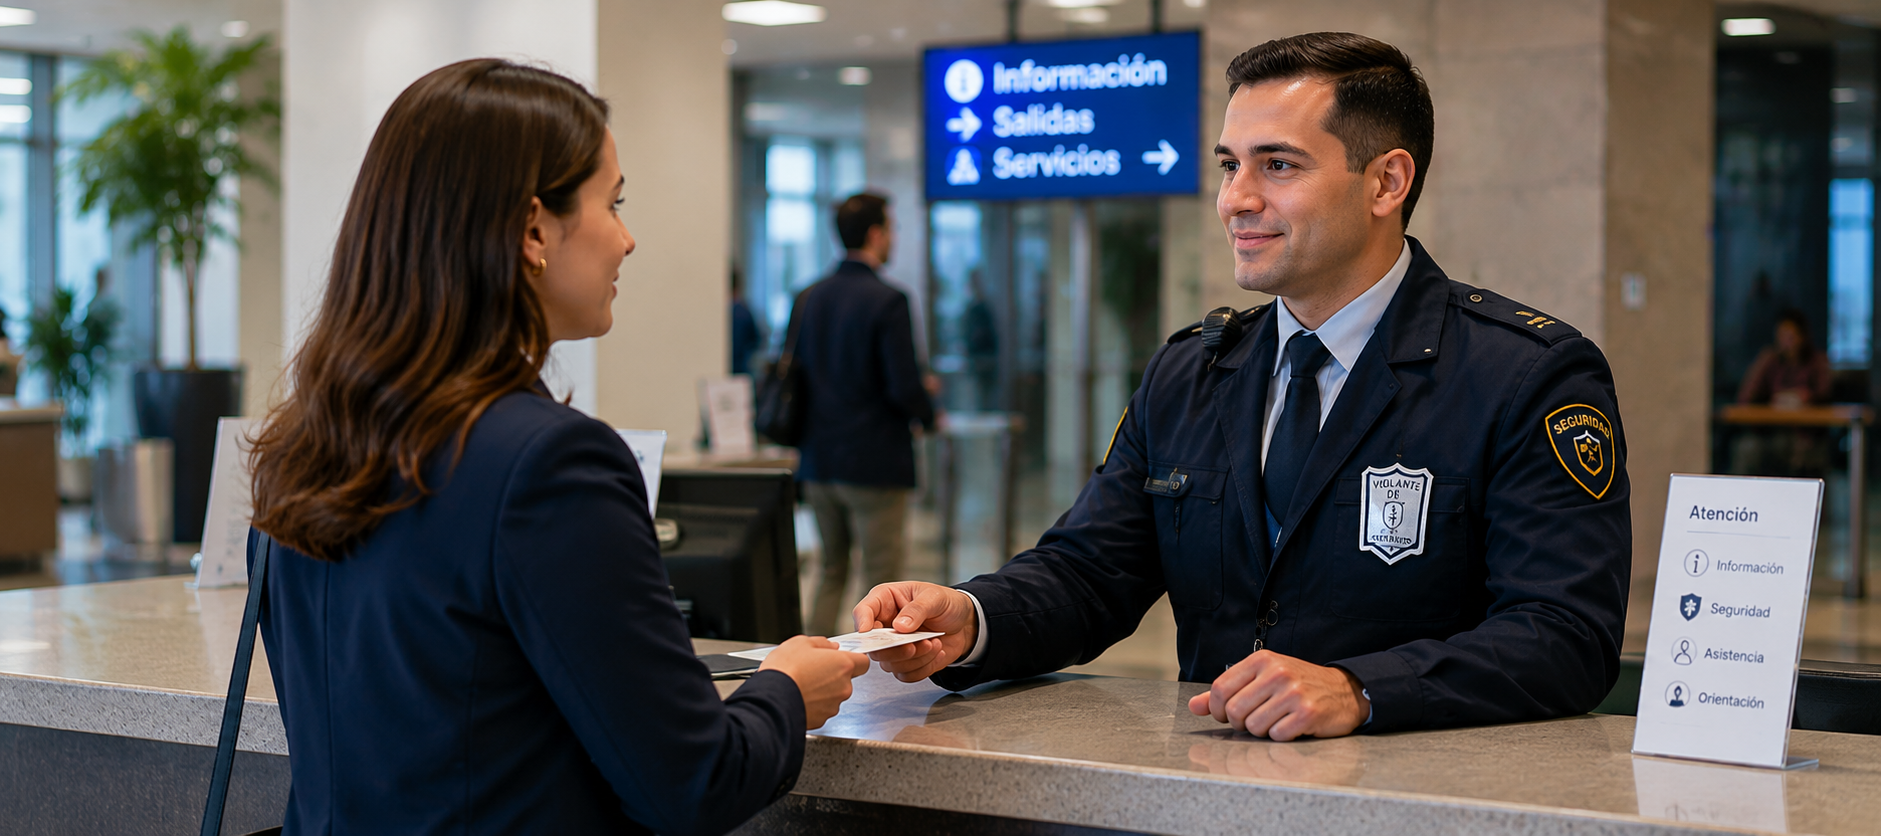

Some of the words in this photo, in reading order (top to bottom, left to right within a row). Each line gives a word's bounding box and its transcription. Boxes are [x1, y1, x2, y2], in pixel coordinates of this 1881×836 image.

[993, 52, 1168, 95] Información
[993, 102, 1096, 138] Salidas
[993, 143, 1122, 180] Servicios
[1689, 505, 1759, 523] Atención
[1716, 559, 1784, 575] Información
[1710, 602, 1771, 619] Seguridad
[1703, 648, 1765, 664] Asistencia
[1698, 691, 1765, 709] Orientación
